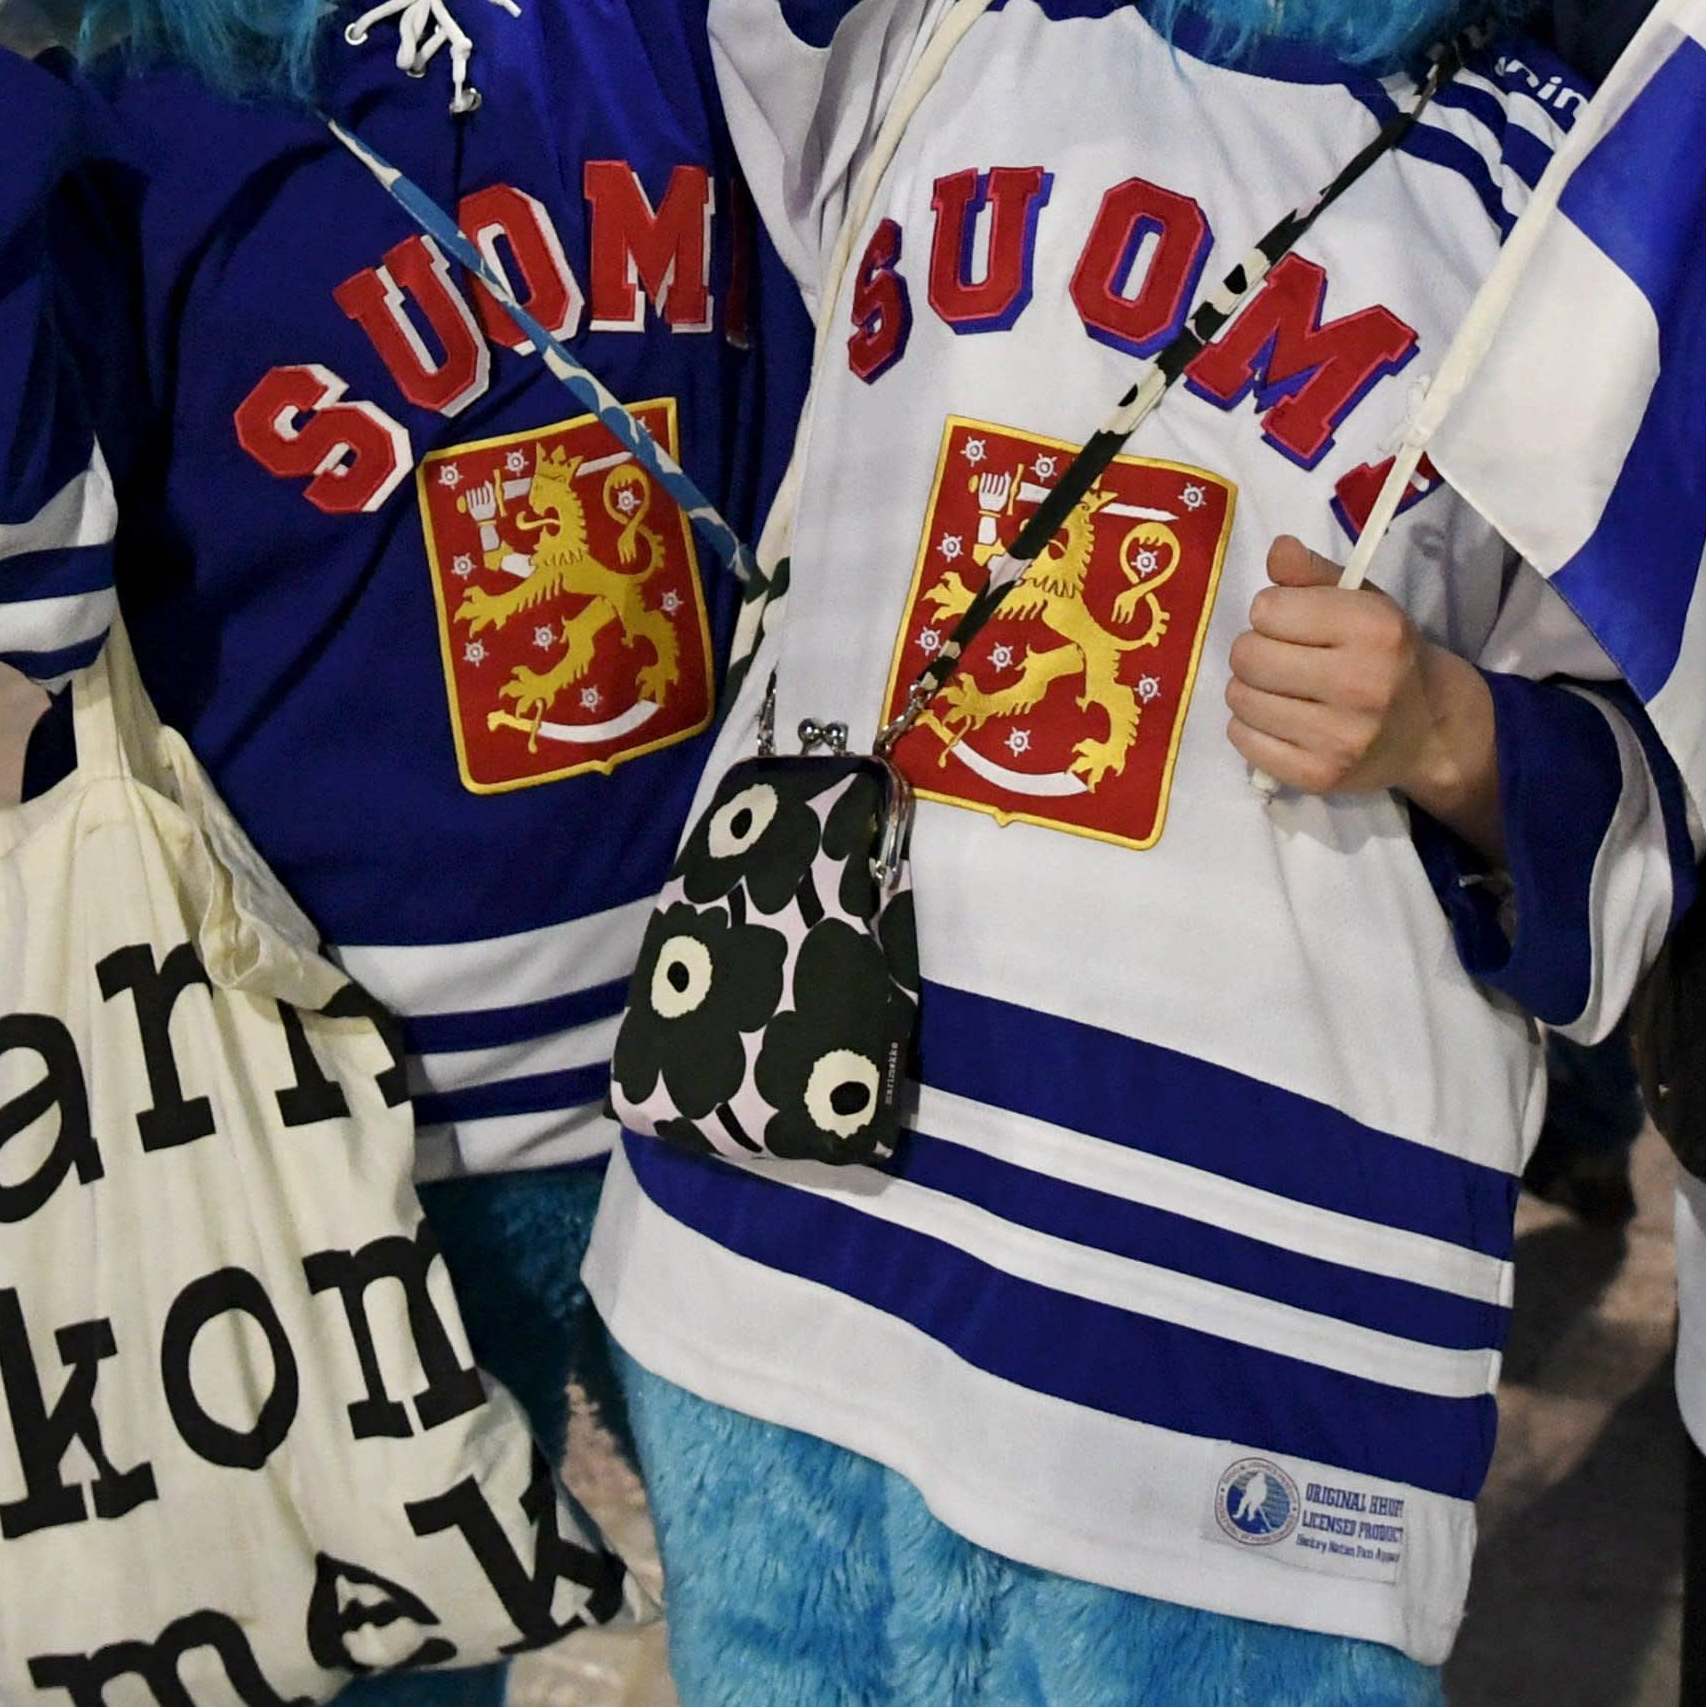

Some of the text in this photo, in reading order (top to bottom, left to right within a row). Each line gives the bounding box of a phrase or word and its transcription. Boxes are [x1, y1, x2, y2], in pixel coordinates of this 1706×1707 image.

[884, 1041, 899, 1106] marimekko
[1306, 1483, 1366, 1511] ORIGINAL
[1302, 1510, 1404, 1542] LICENSED PRODUCT
